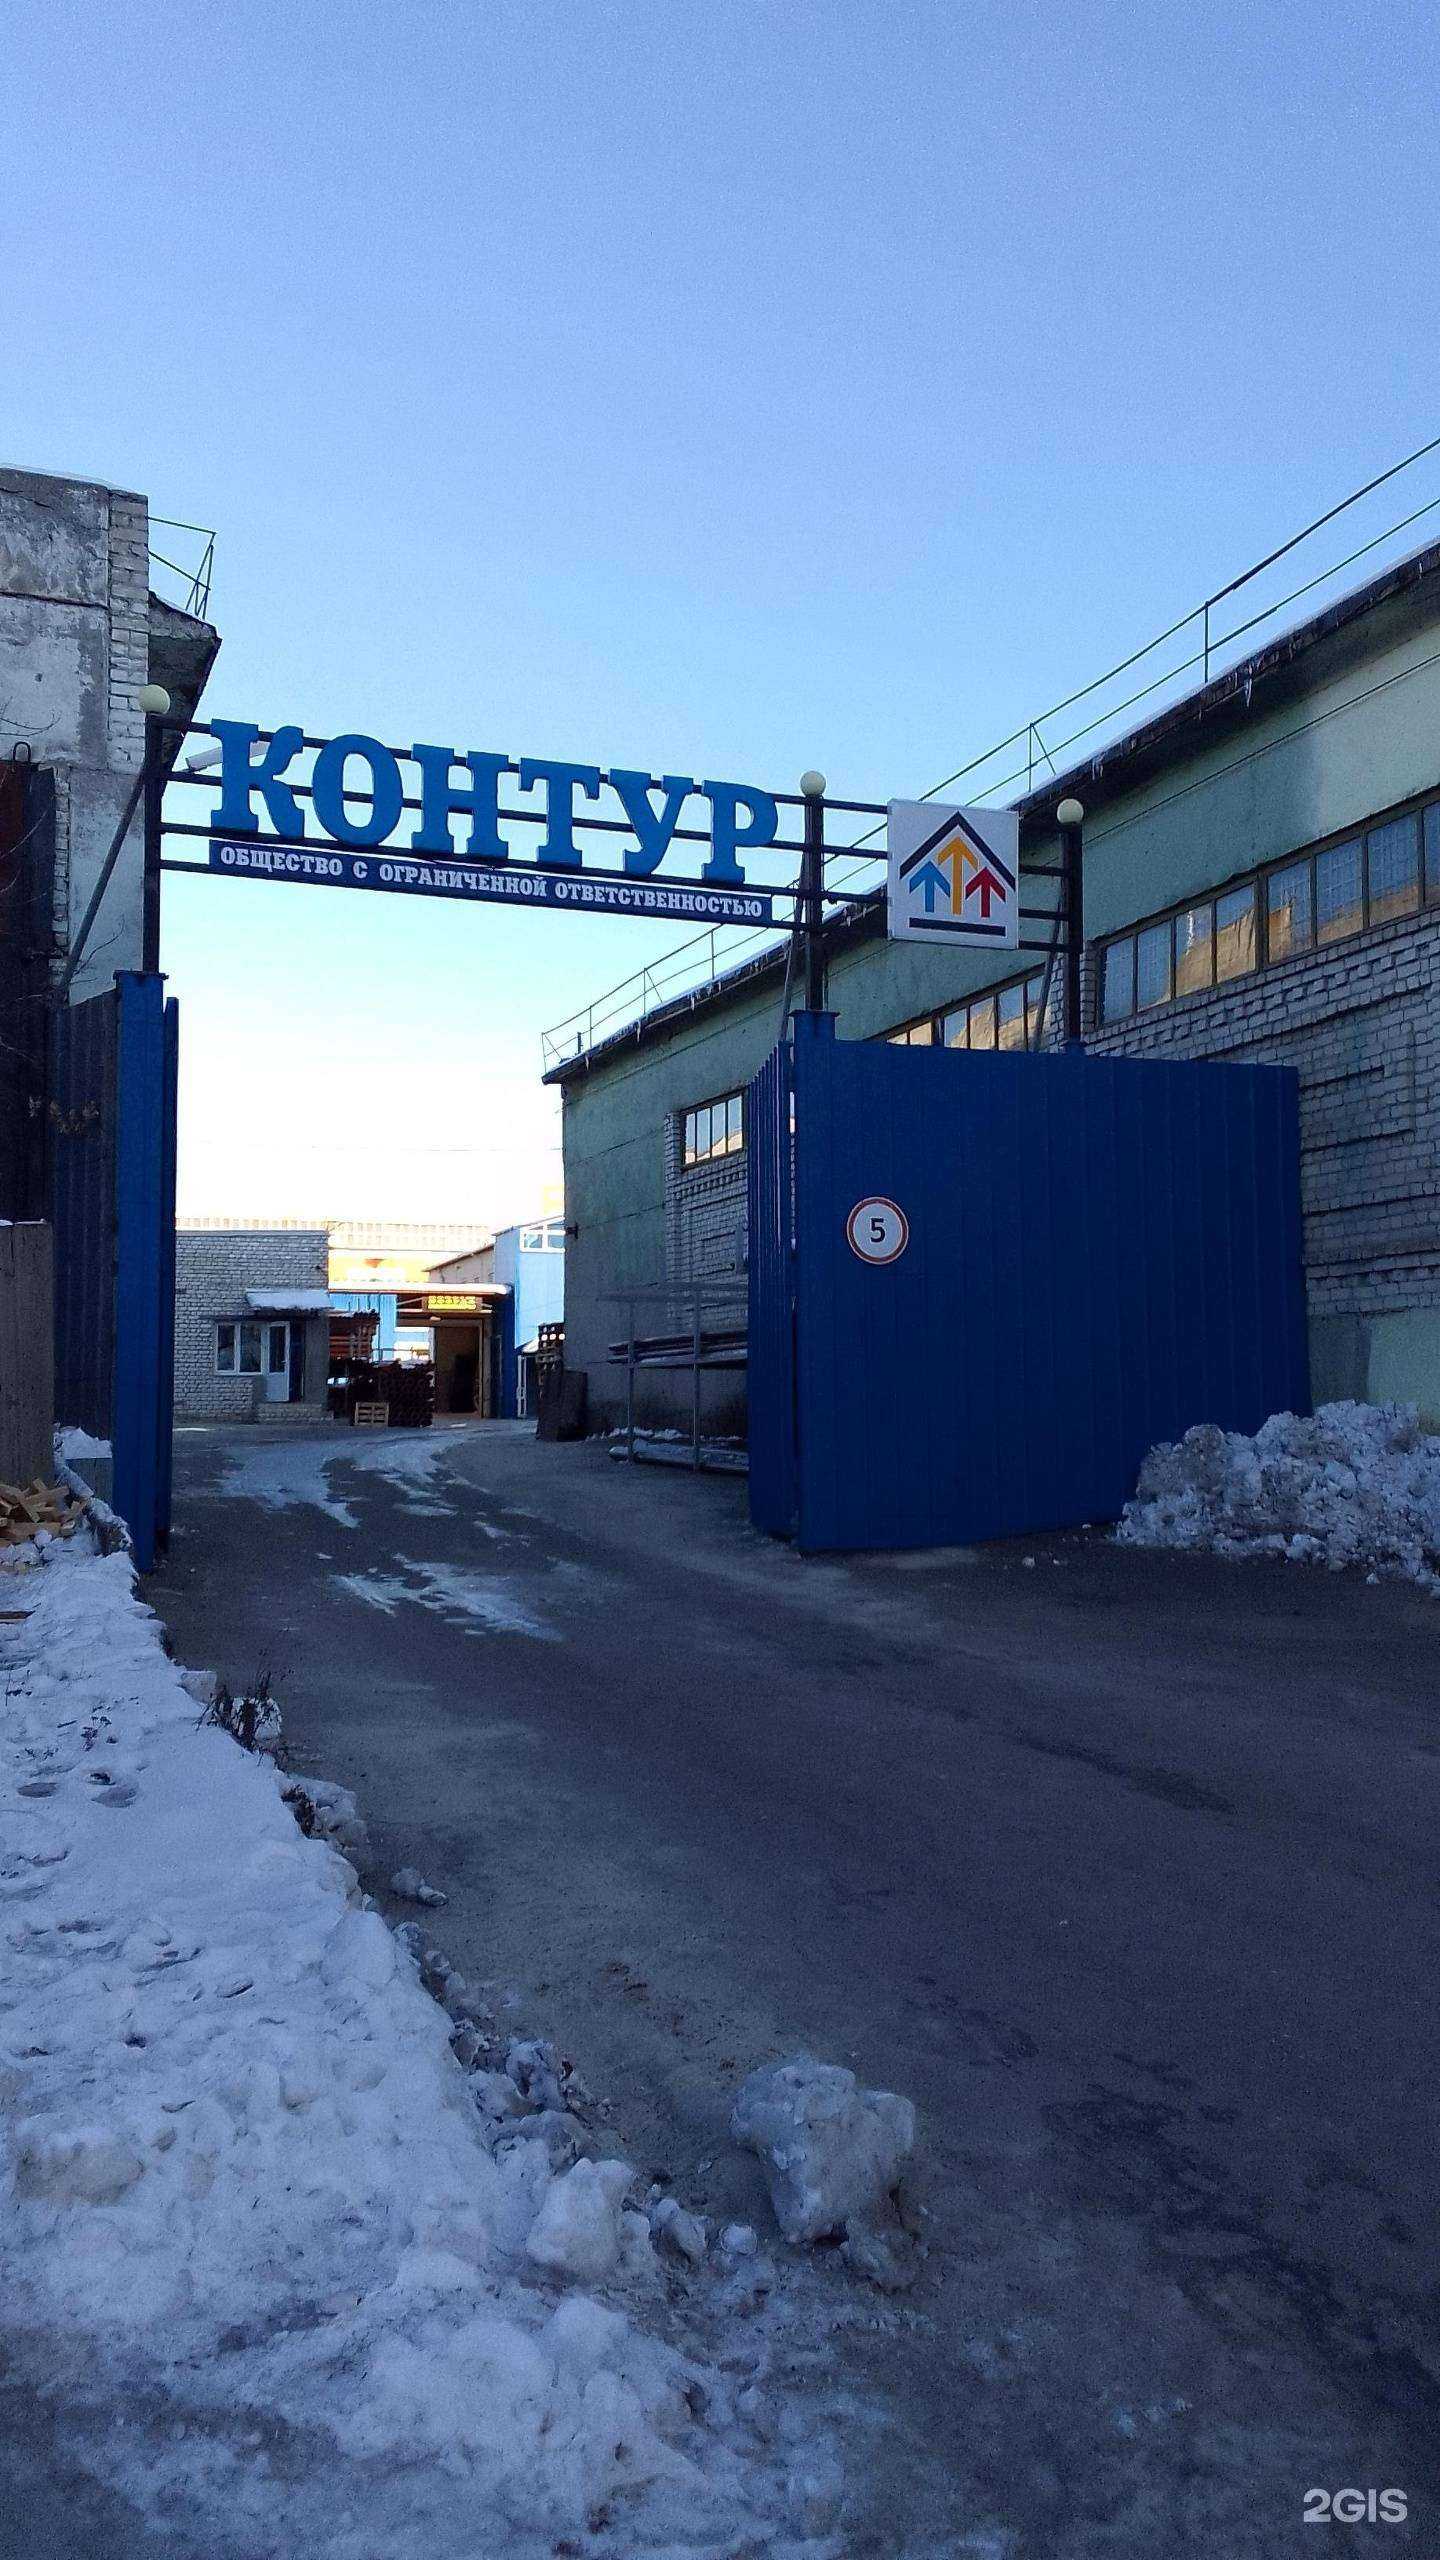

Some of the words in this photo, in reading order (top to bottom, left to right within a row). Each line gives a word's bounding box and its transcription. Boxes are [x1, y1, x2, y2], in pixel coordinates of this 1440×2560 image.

[211, 718, 778, 884] КОНТУР
[220, 846, 343, 876] ОБЩЕСТВО
[352, 861, 368, 879] С
[379, 863, 548, 898] ОГРАНИЧЕННОЙ
[555, 881, 762, 918] ОТВЕТСТВЕННОСТЬЮ
[870, 1217, 886, 1243] 5
